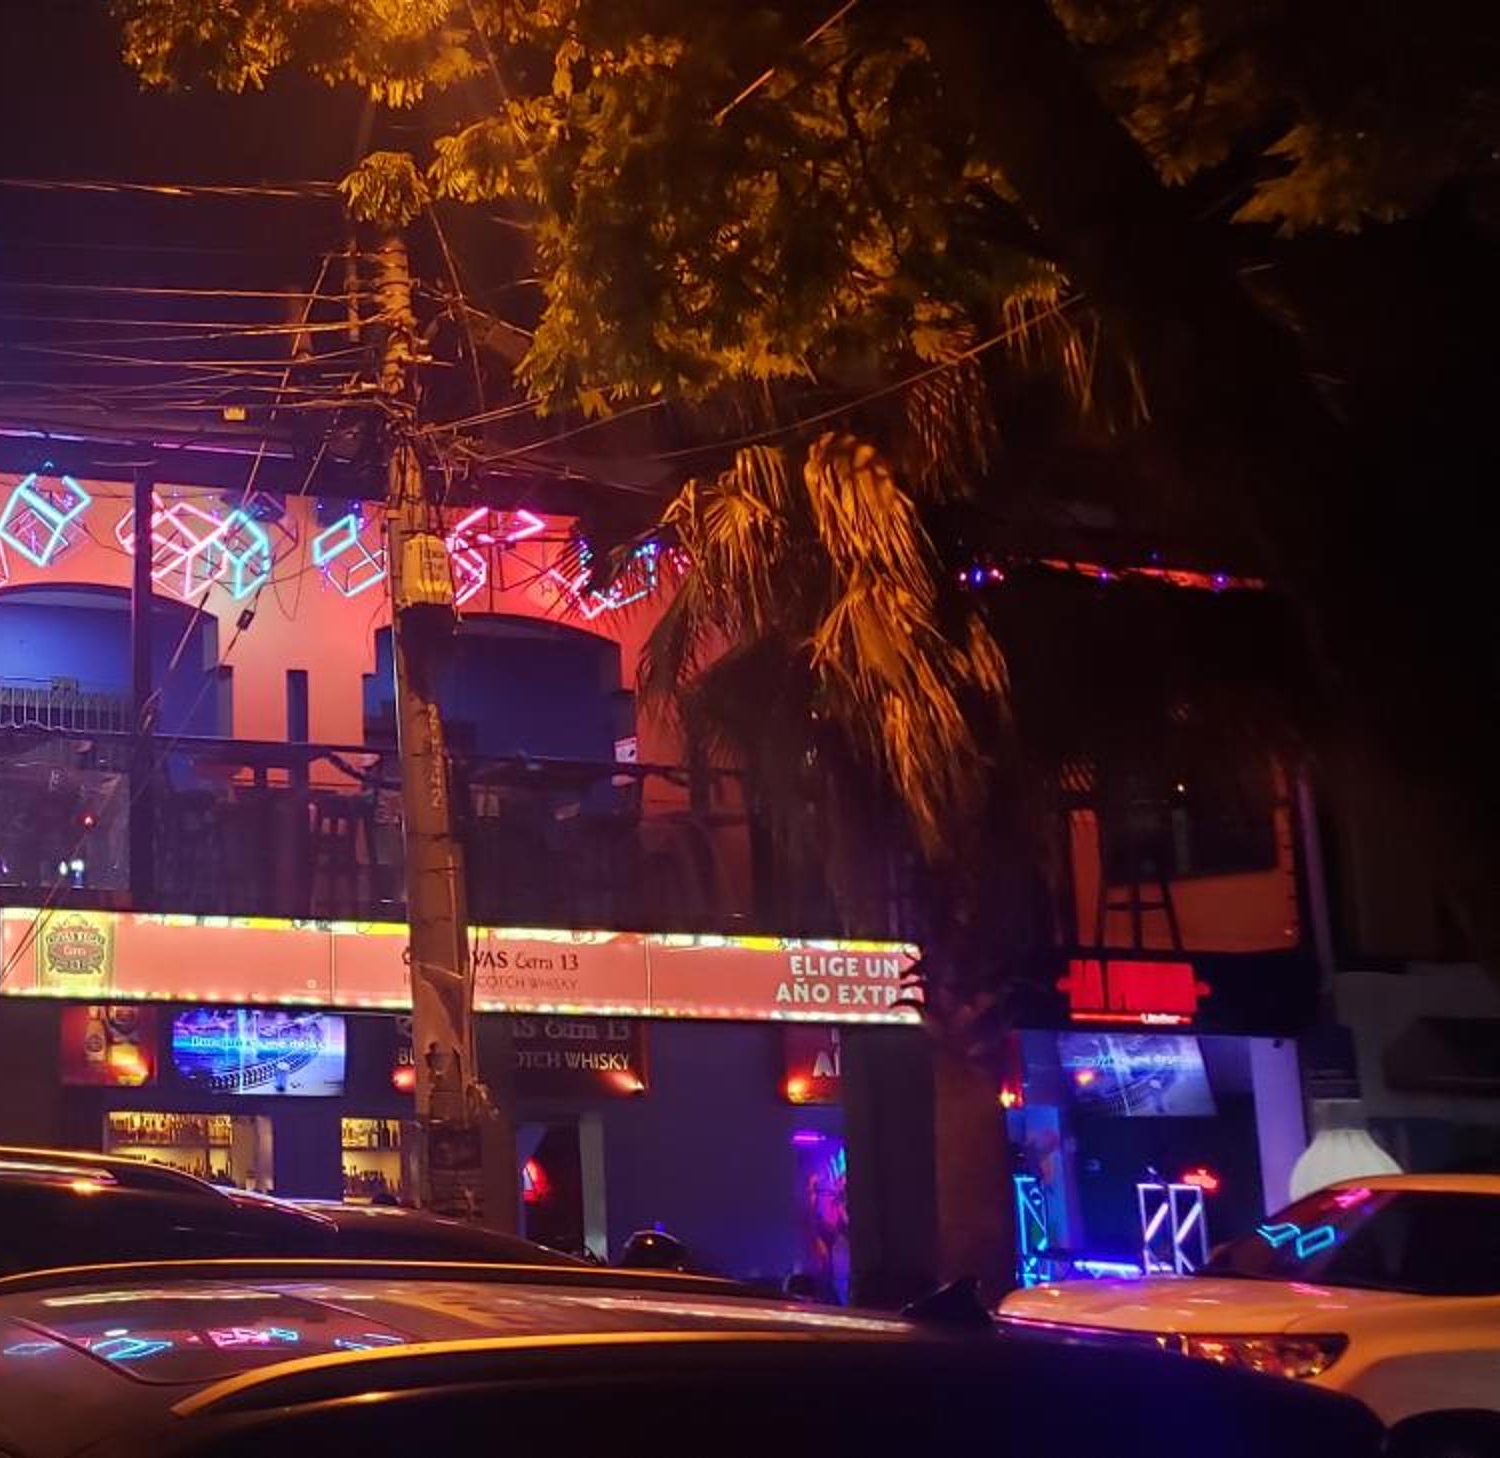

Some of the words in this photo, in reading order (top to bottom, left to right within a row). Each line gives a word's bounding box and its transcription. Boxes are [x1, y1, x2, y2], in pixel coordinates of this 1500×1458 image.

[402, 947, 508, 969] CVAS
[561, 953, 580, 971] 13
[790, 955, 859, 977] ELIGE
[865, 958, 900, 979] UN
[529, 979, 579, 992] WHISKY
[776, 977, 831, 1003] AÑO
[565, 1052, 630, 1071] WHISKY
